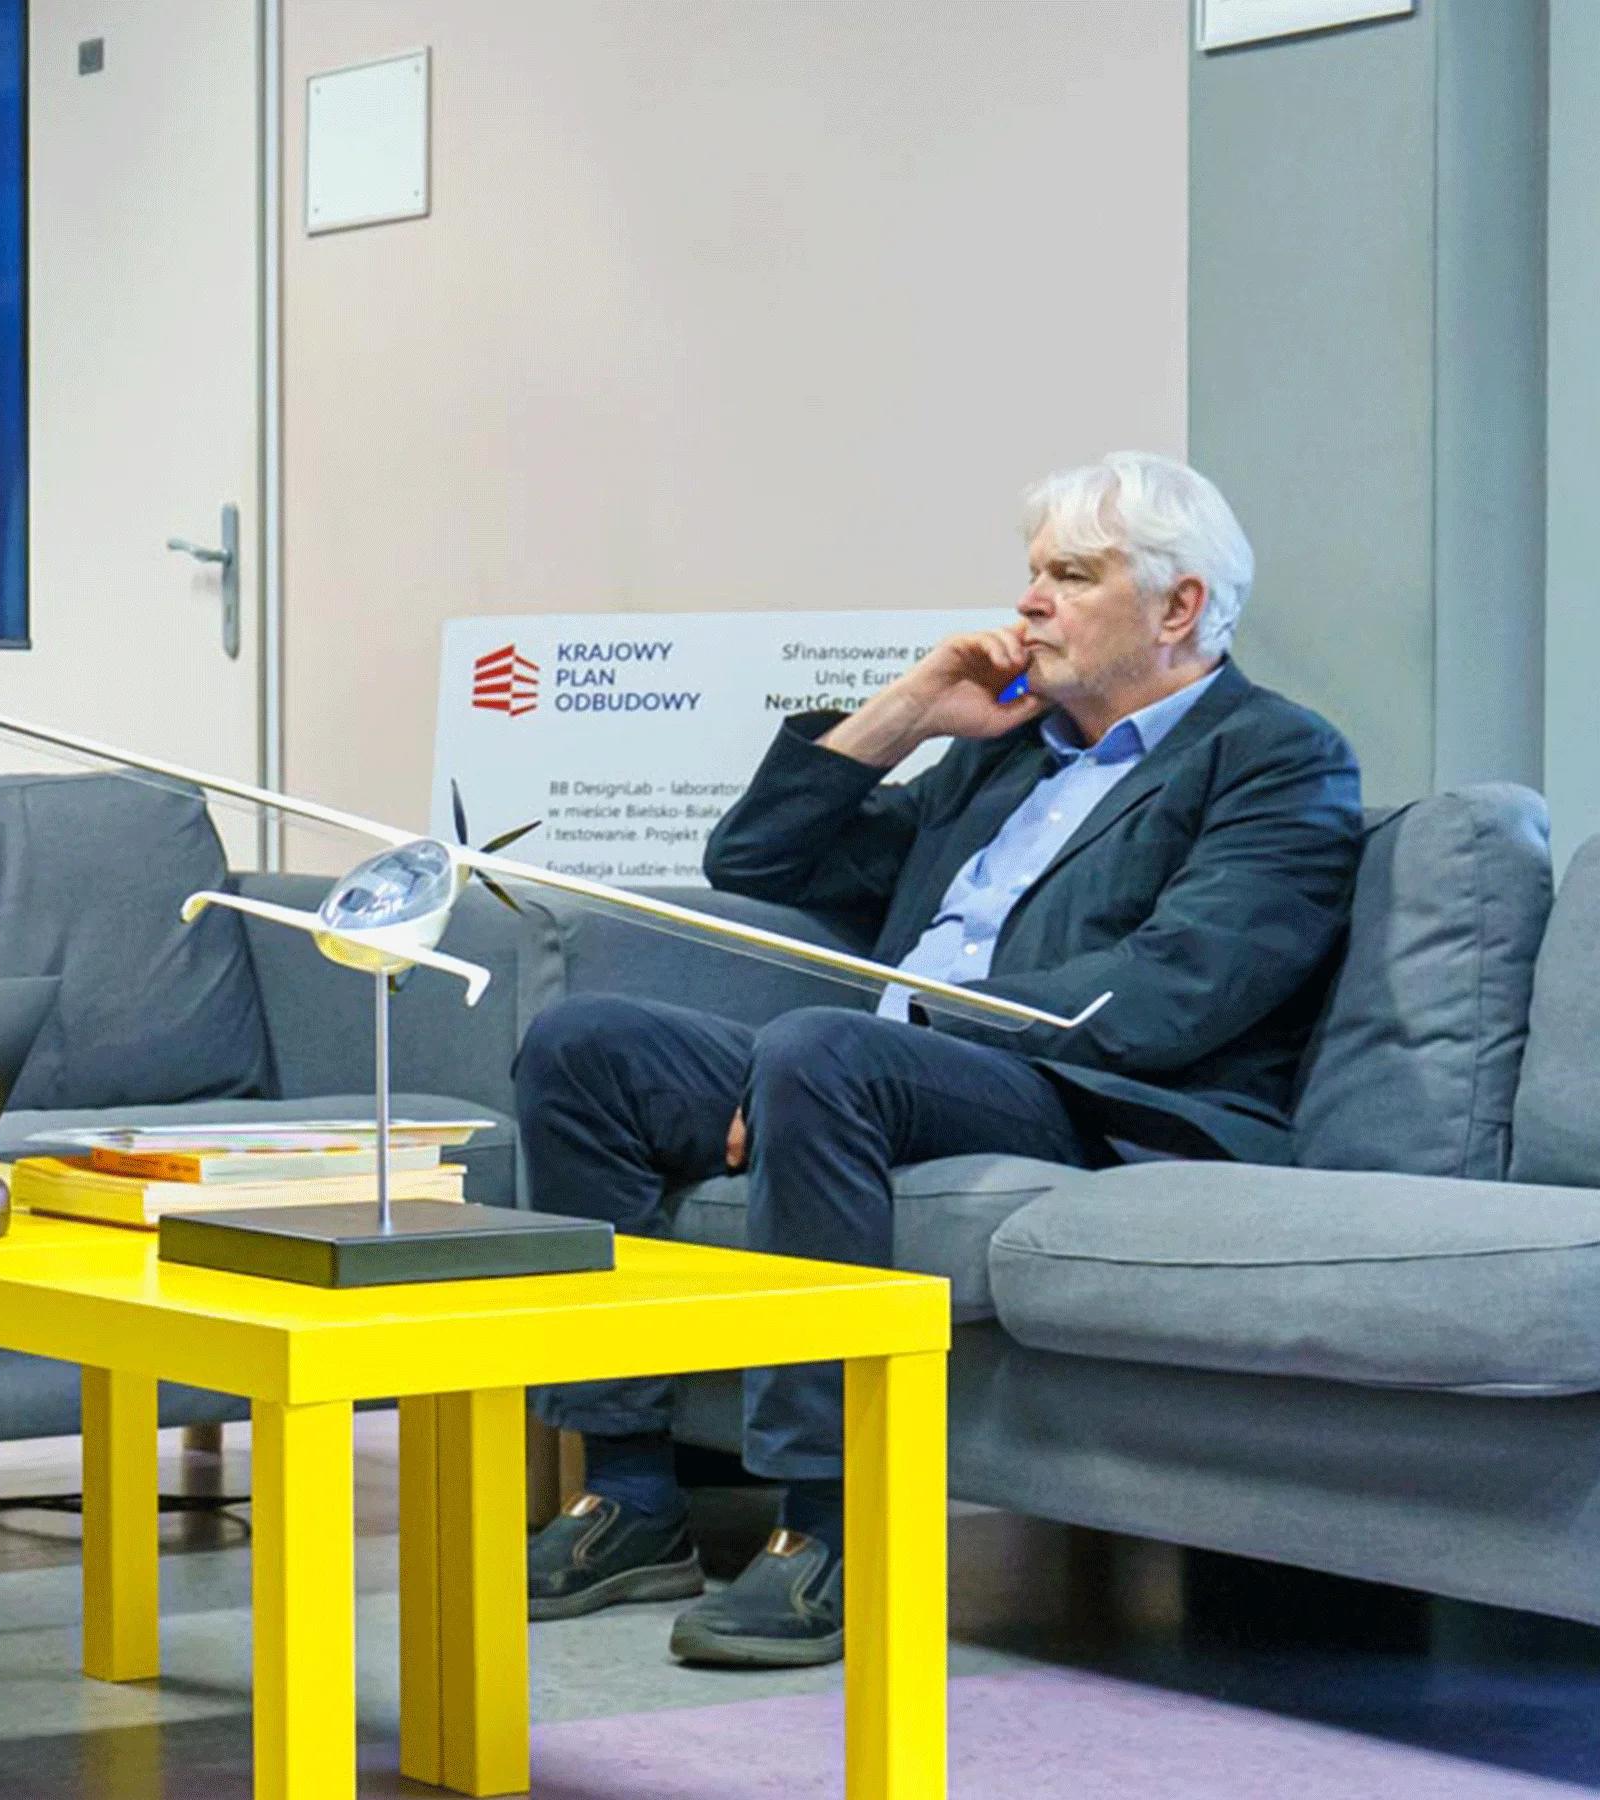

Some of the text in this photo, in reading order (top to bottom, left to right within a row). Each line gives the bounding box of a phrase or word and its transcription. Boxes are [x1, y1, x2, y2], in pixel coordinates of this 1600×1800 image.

[557, 642, 673, 662] KRAJOWY
[782, 642, 908, 660] Sfinansowane
[556, 668, 615, 687] PLAN
[815, 669, 857, 688] Unię
[555, 692, 701, 712] ODBUDOWY
[573, 780, 653, 799] DesignLab
[644, 827, 699, 846] Projekt
